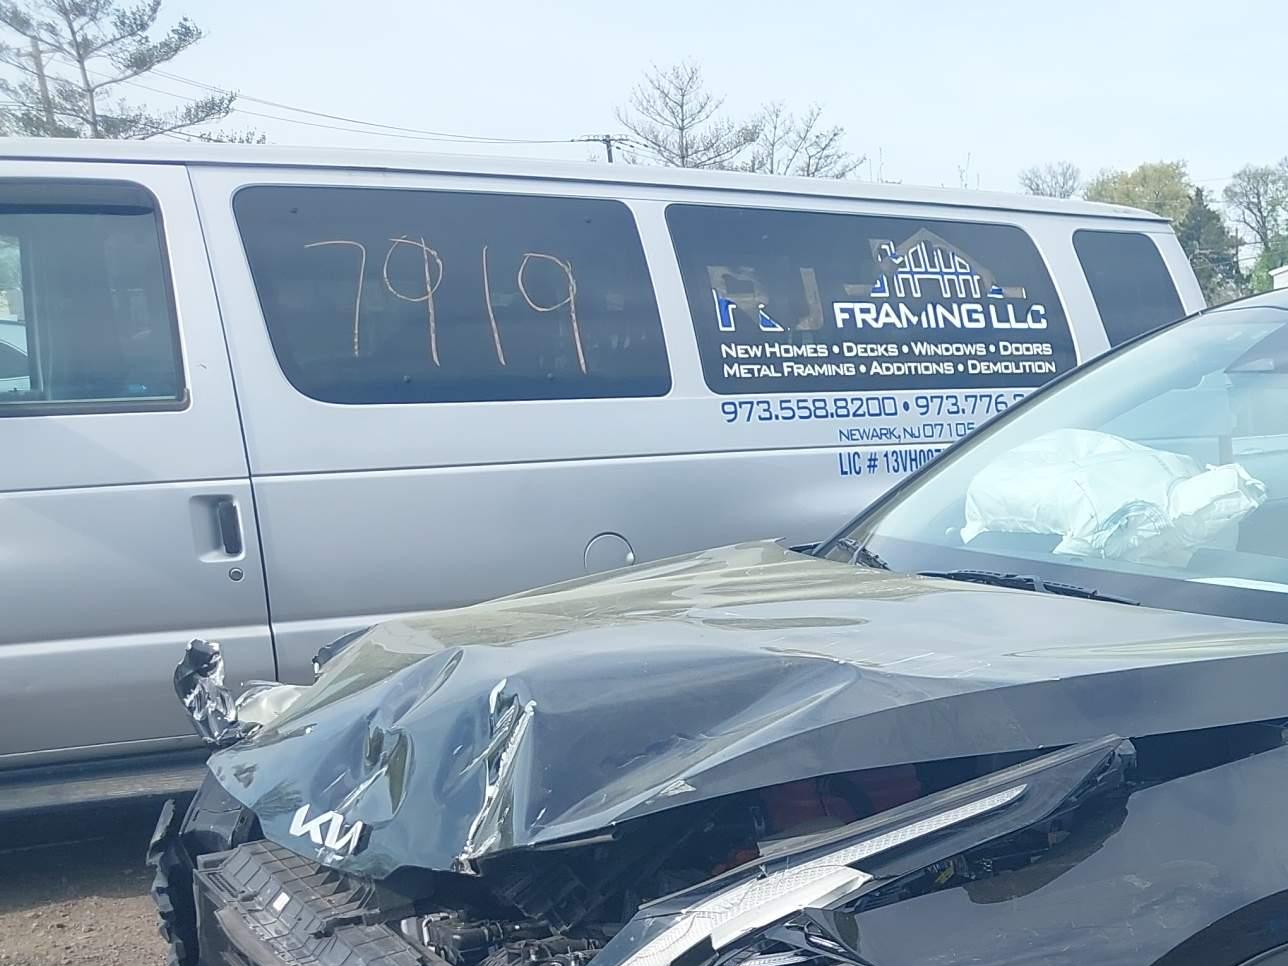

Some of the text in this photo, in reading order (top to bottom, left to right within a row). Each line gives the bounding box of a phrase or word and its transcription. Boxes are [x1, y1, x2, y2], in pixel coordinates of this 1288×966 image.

[304, 234, 588, 375] 7919
[832, 302, 1048, 329] FRAMING LLC
[720, 341, 1053, 358] NEW HOMES DECKS WINDOWS DOORS
[723, 359, 1057, 378] METAL FRAMING ADDITIONS DEMOLITION
[720, 396, 898, 423] 973.558.8200
[903, 426, 921, 439] NJ
[838, 451, 862, 476] LIC
[866, 452, 879, 474] #
